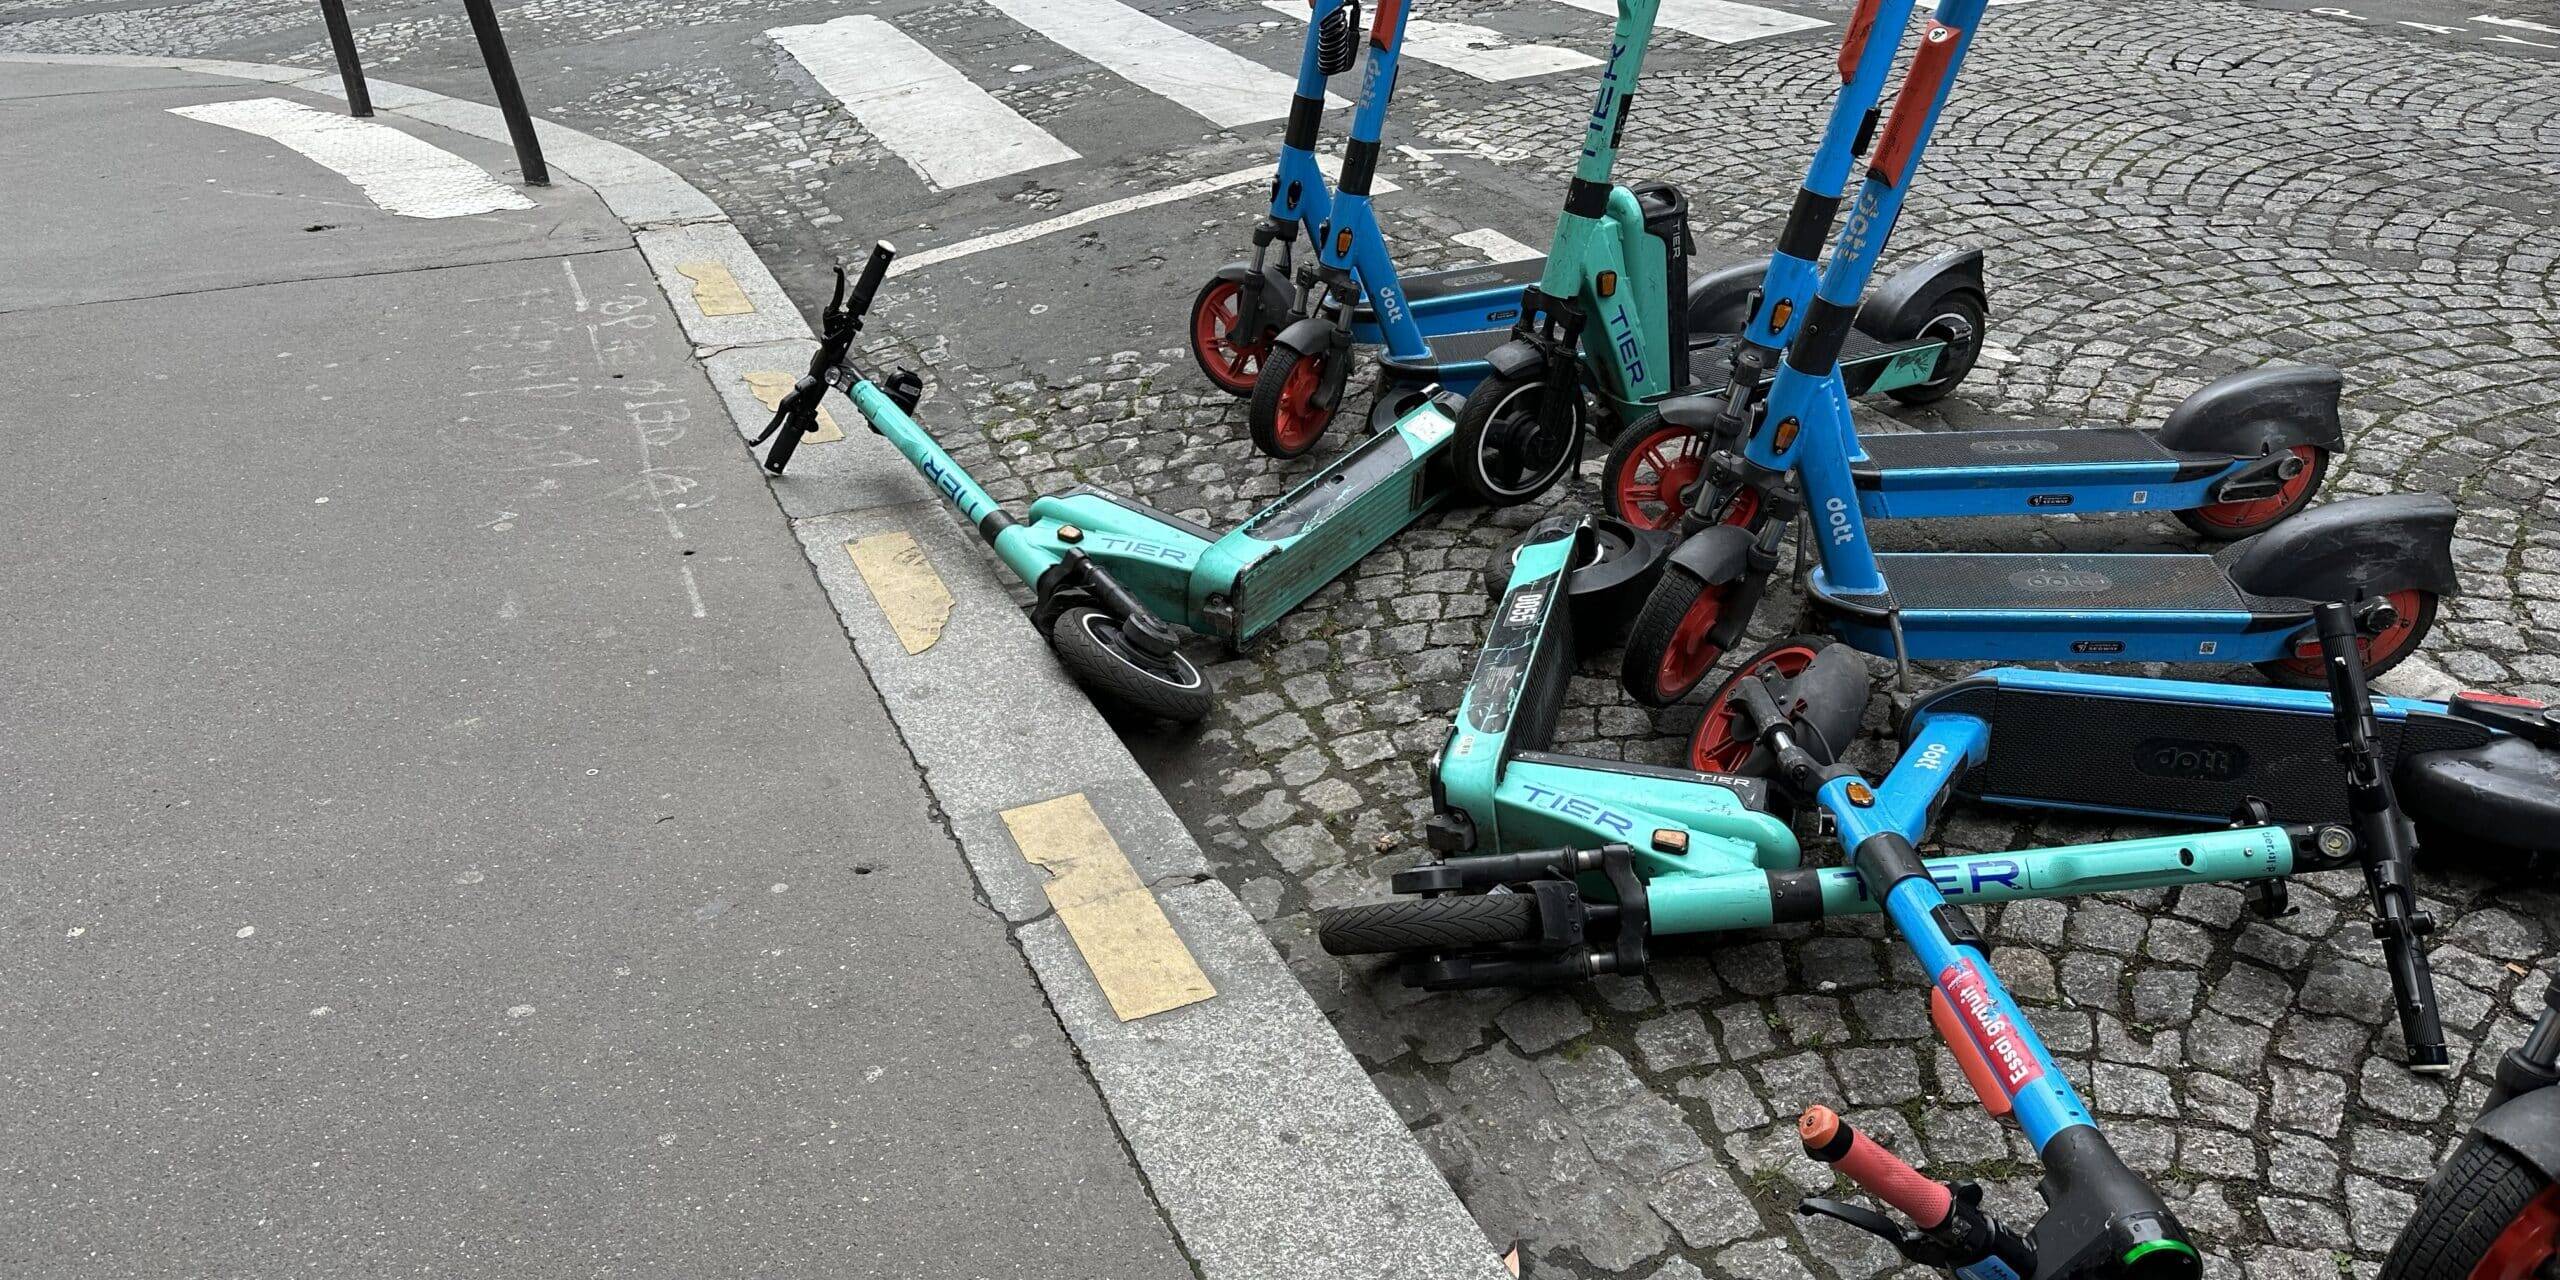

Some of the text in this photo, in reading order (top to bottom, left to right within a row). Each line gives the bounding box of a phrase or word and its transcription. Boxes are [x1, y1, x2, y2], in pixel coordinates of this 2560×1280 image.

[1671, 218, 1681, 259] TIER
[1380, 286, 1403, 324] dott
[1610, 304, 1644, 388] TIER
[923, 455, 978, 527] TIER
[1085, 484, 1118, 501] TIER
[1826, 497, 1854, 546] dott
[1101, 537, 1187, 563] TIER
[1509, 593, 1543, 623] 0055
[1913, 743, 1949, 770] dott
[1695, 773, 1750, 788] TIER
[1523, 784, 1634, 837] TIER
[1833, 860, 2024, 901] TER
[1960, 985, 2006, 1038] gratuit
[1989, 1036, 2029, 1085] Essai
